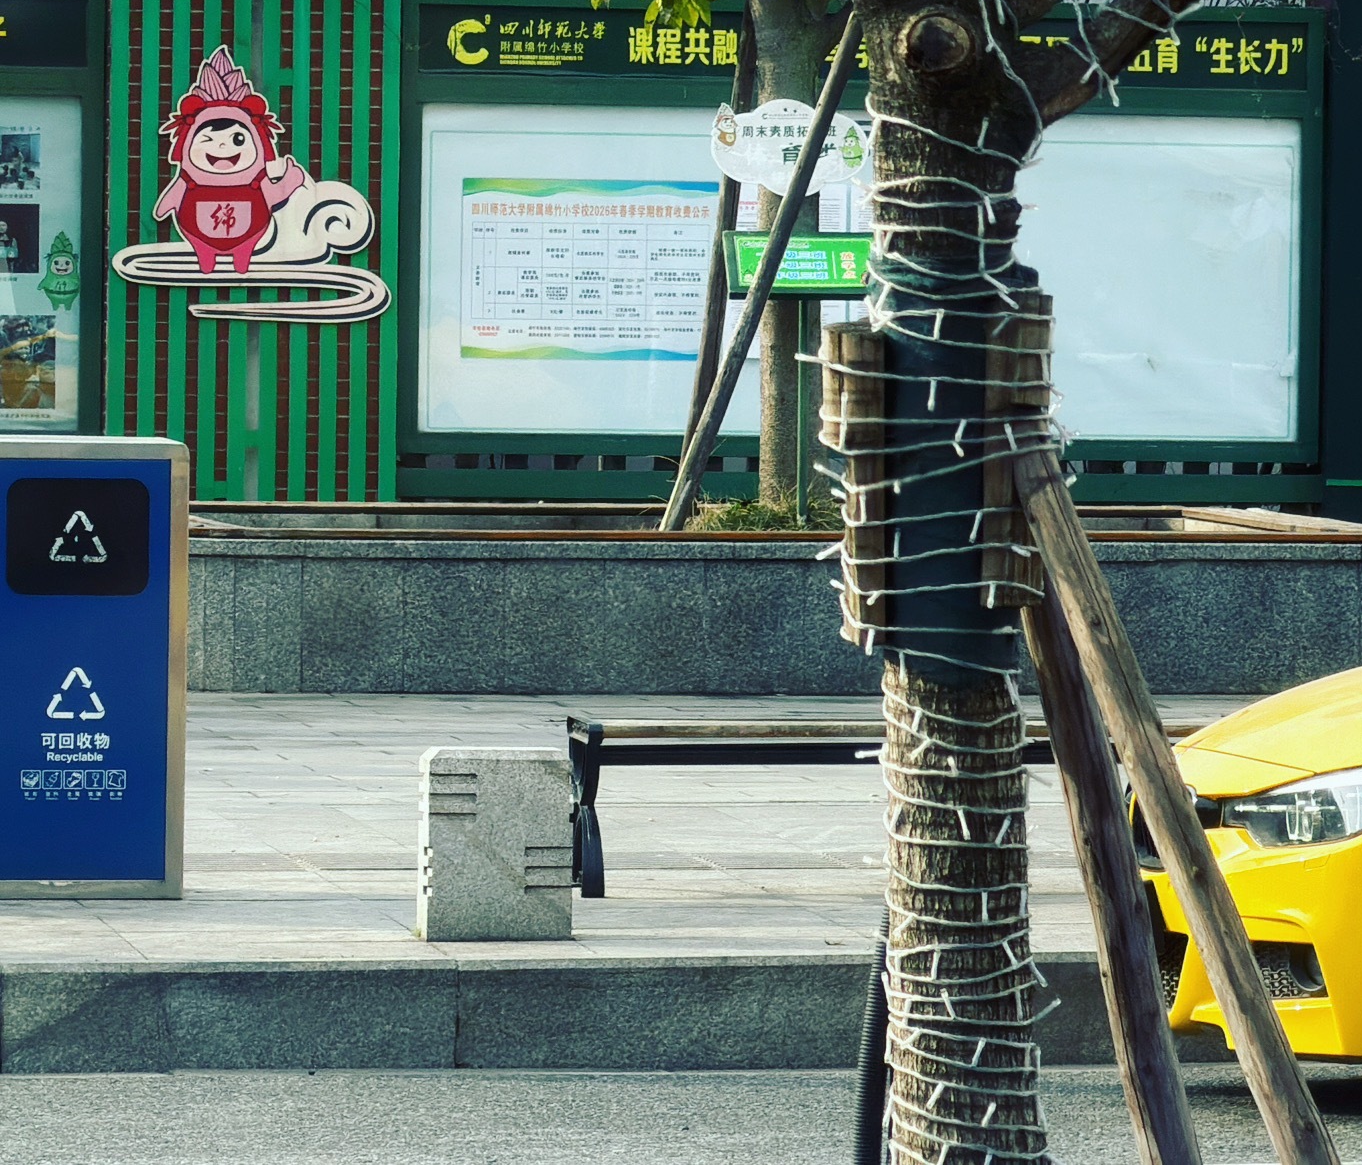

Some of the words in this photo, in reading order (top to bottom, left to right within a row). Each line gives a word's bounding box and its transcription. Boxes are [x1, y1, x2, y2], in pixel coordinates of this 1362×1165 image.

[500, 40, 585, 54] 附属绵竹小学校
[628, 26, 739, 67] 课程共融
[210, 203, 236, 238] 绵
[41, 733, 110, 749] 可回收物
[46, 752, 104, 764] Recyclable
